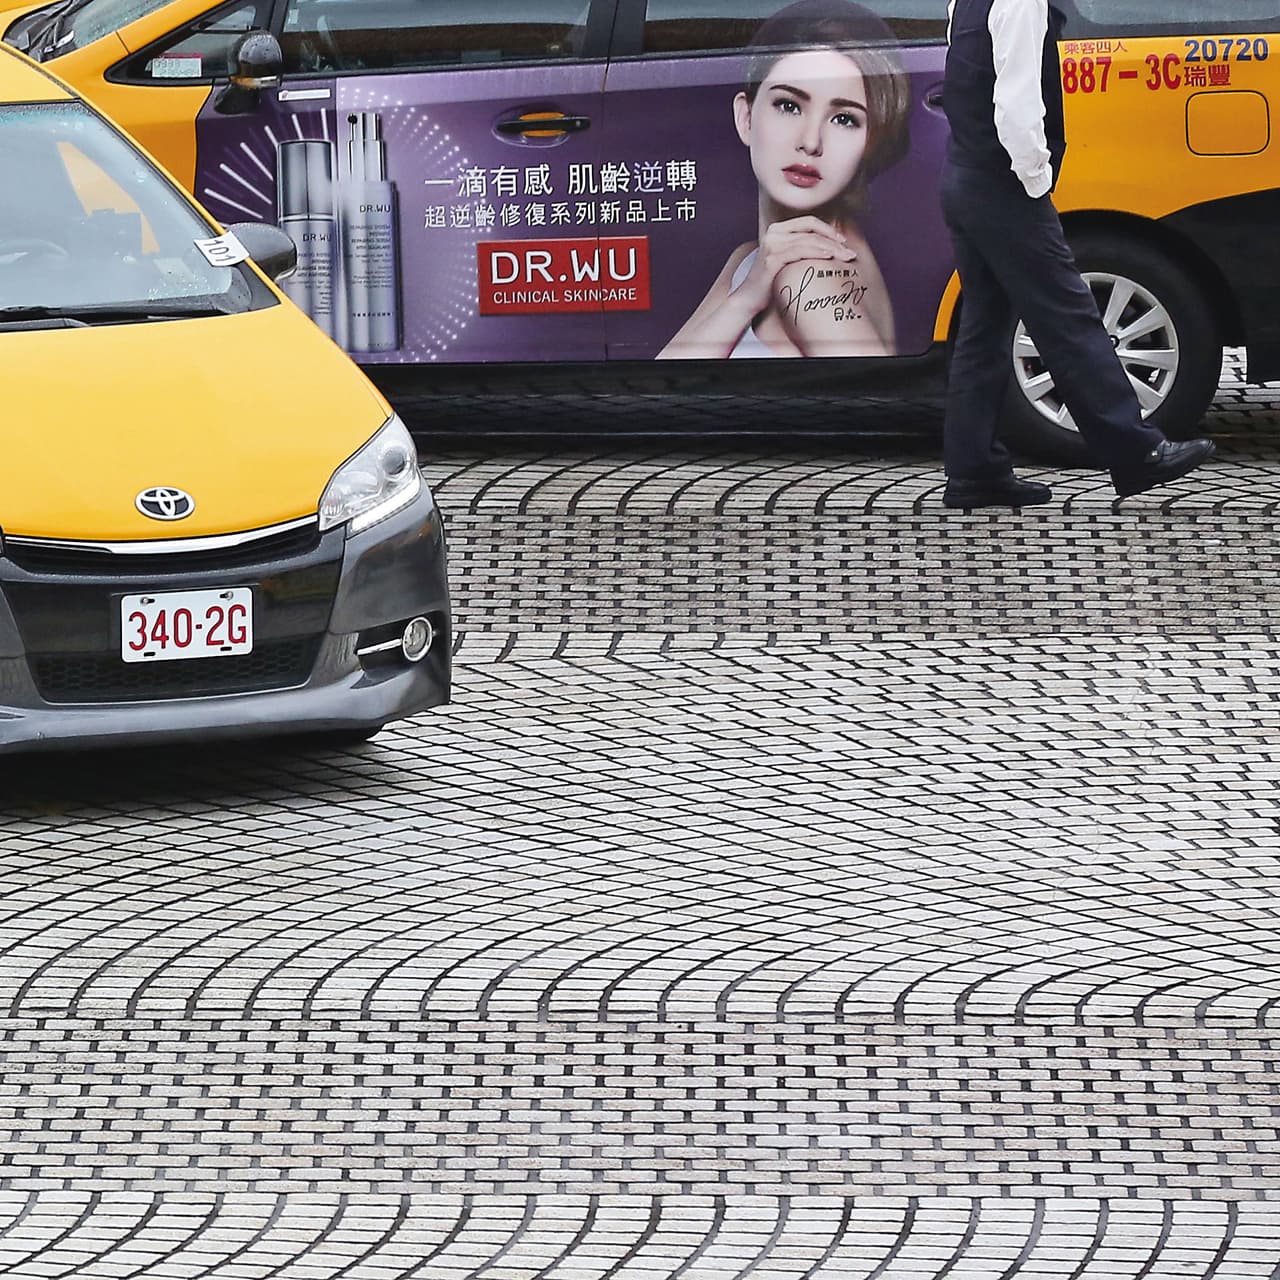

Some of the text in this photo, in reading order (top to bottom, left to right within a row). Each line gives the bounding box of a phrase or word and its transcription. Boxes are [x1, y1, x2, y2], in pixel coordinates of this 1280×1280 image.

[1063, 41, 1128, 55] 乘客四人
[1183, 37, 1269, 63] 20720
[1062, 53, 1232, 95] 887-3C 瑞豐
[424, 159, 697, 198] 一滴有感 肌齡逆轉
[359, 203, 392, 214] DR.WU
[424, 200, 696, 229] 超逆齡修復系列新品上市
[489, 245, 638, 286] DR.WU
[816, 269, 859, 279] 品牌代言人
[493, 287, 637, 305] CLINICAL SKINCARE
[127, 603, 247, 652] 340-2G
